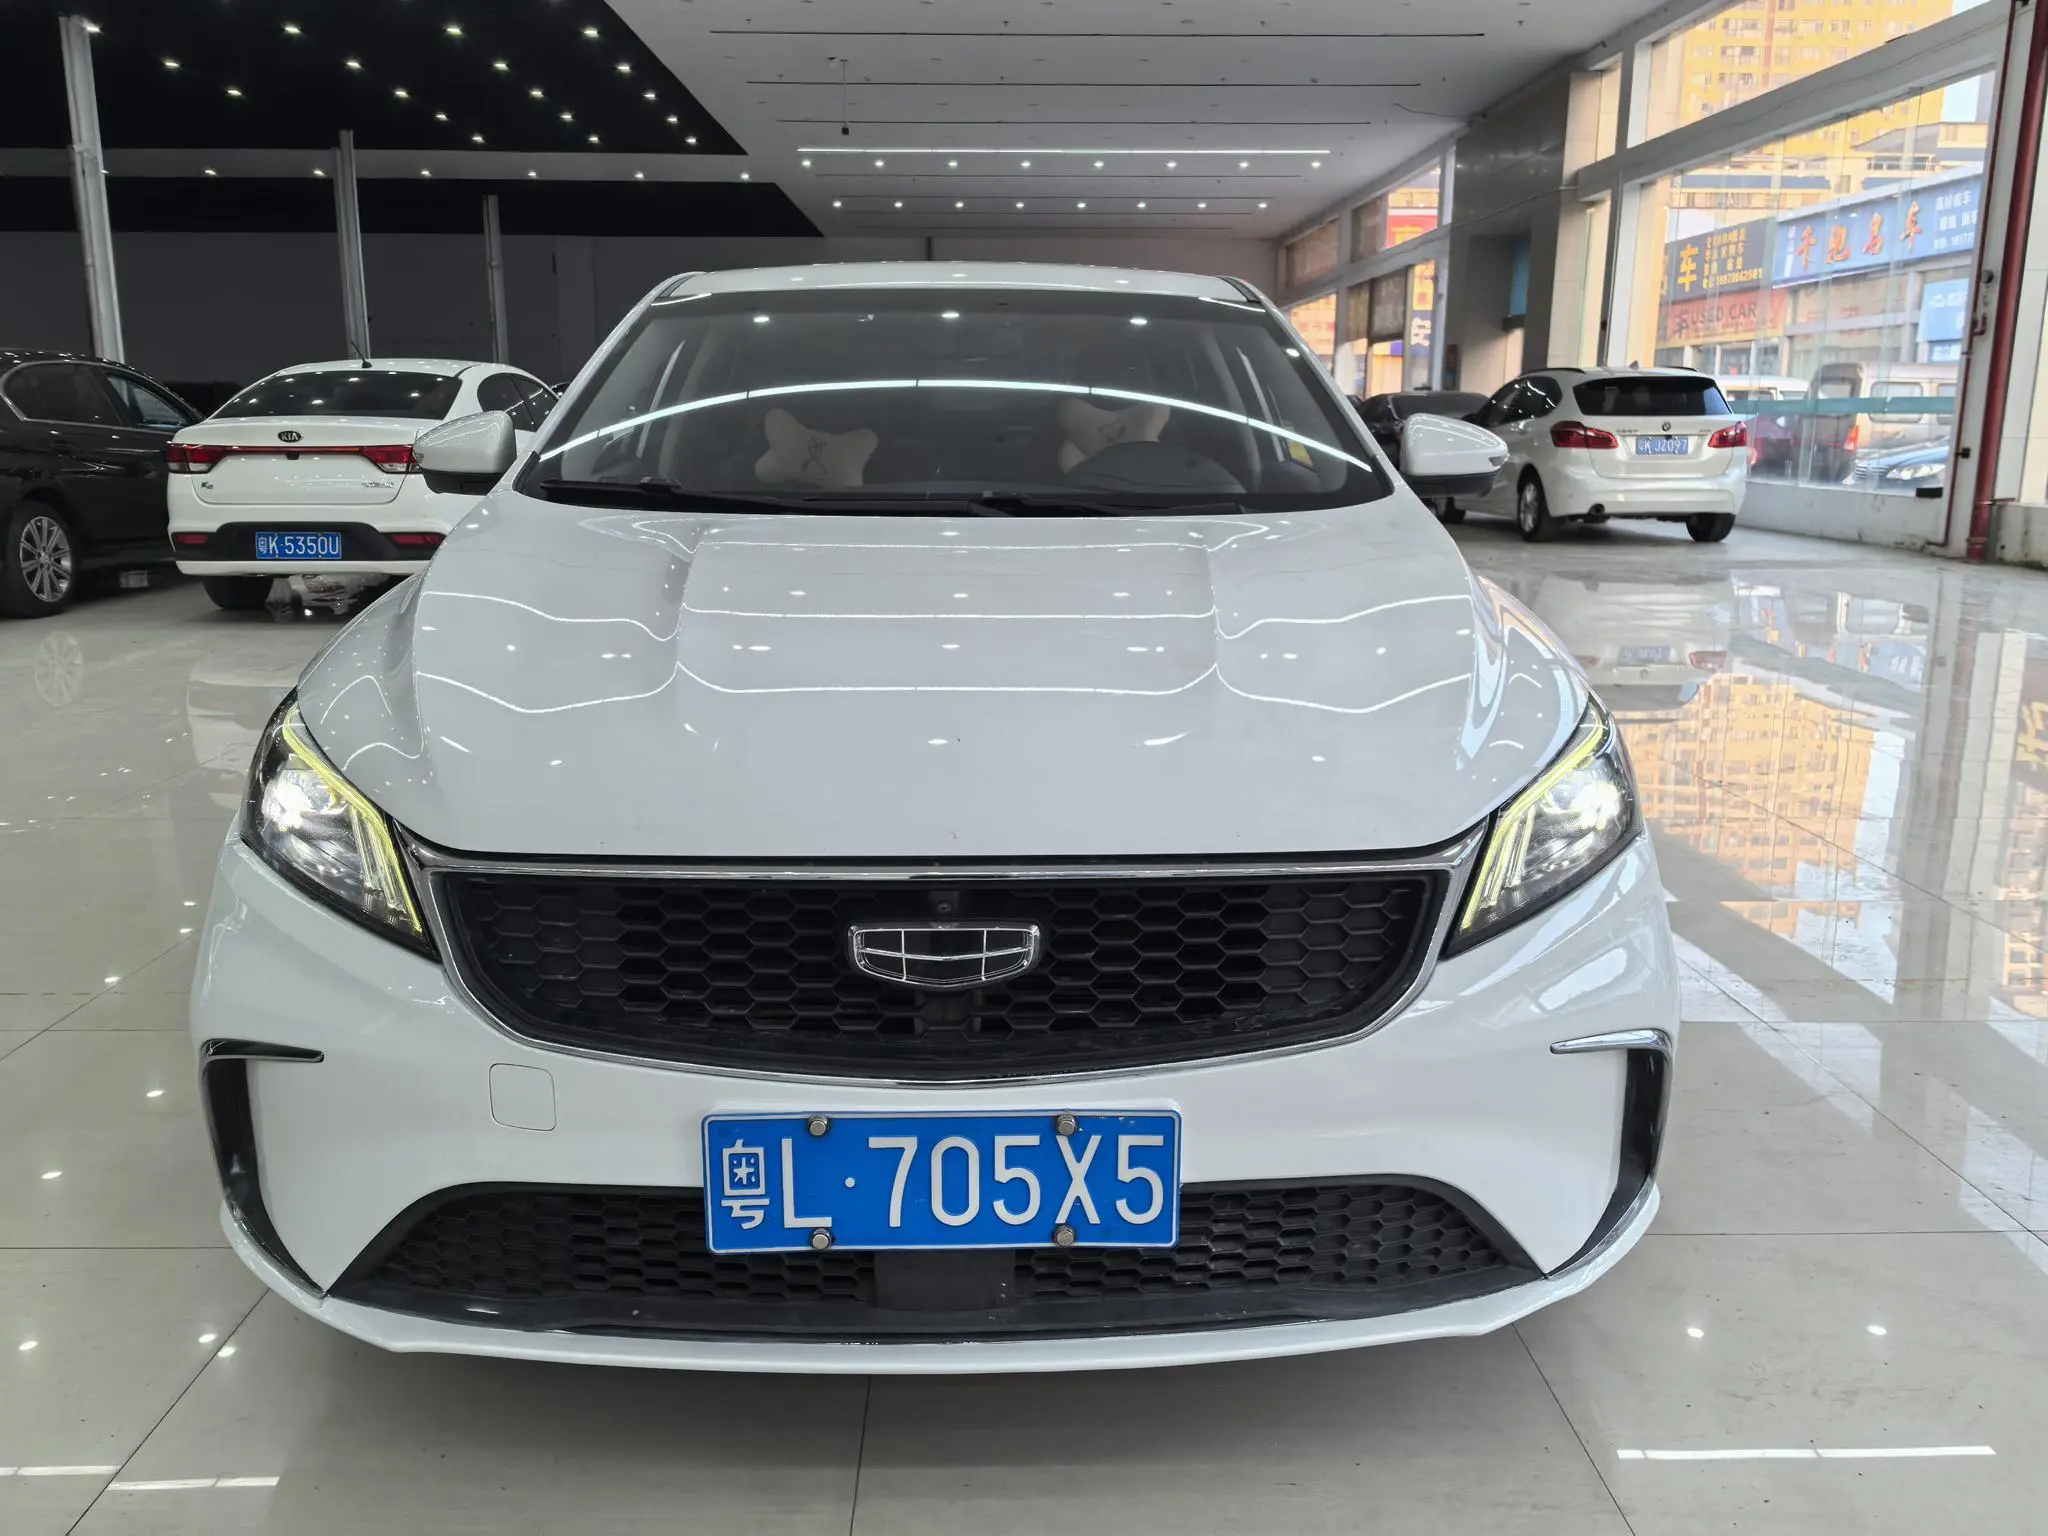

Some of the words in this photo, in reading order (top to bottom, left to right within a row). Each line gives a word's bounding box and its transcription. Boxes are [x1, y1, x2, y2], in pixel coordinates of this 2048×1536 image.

[1729, 301, 1757, 320] CAR
[281, 432, 299, 441] KIA
[721, 1134, 1165, 1230] 粤L·705X5
